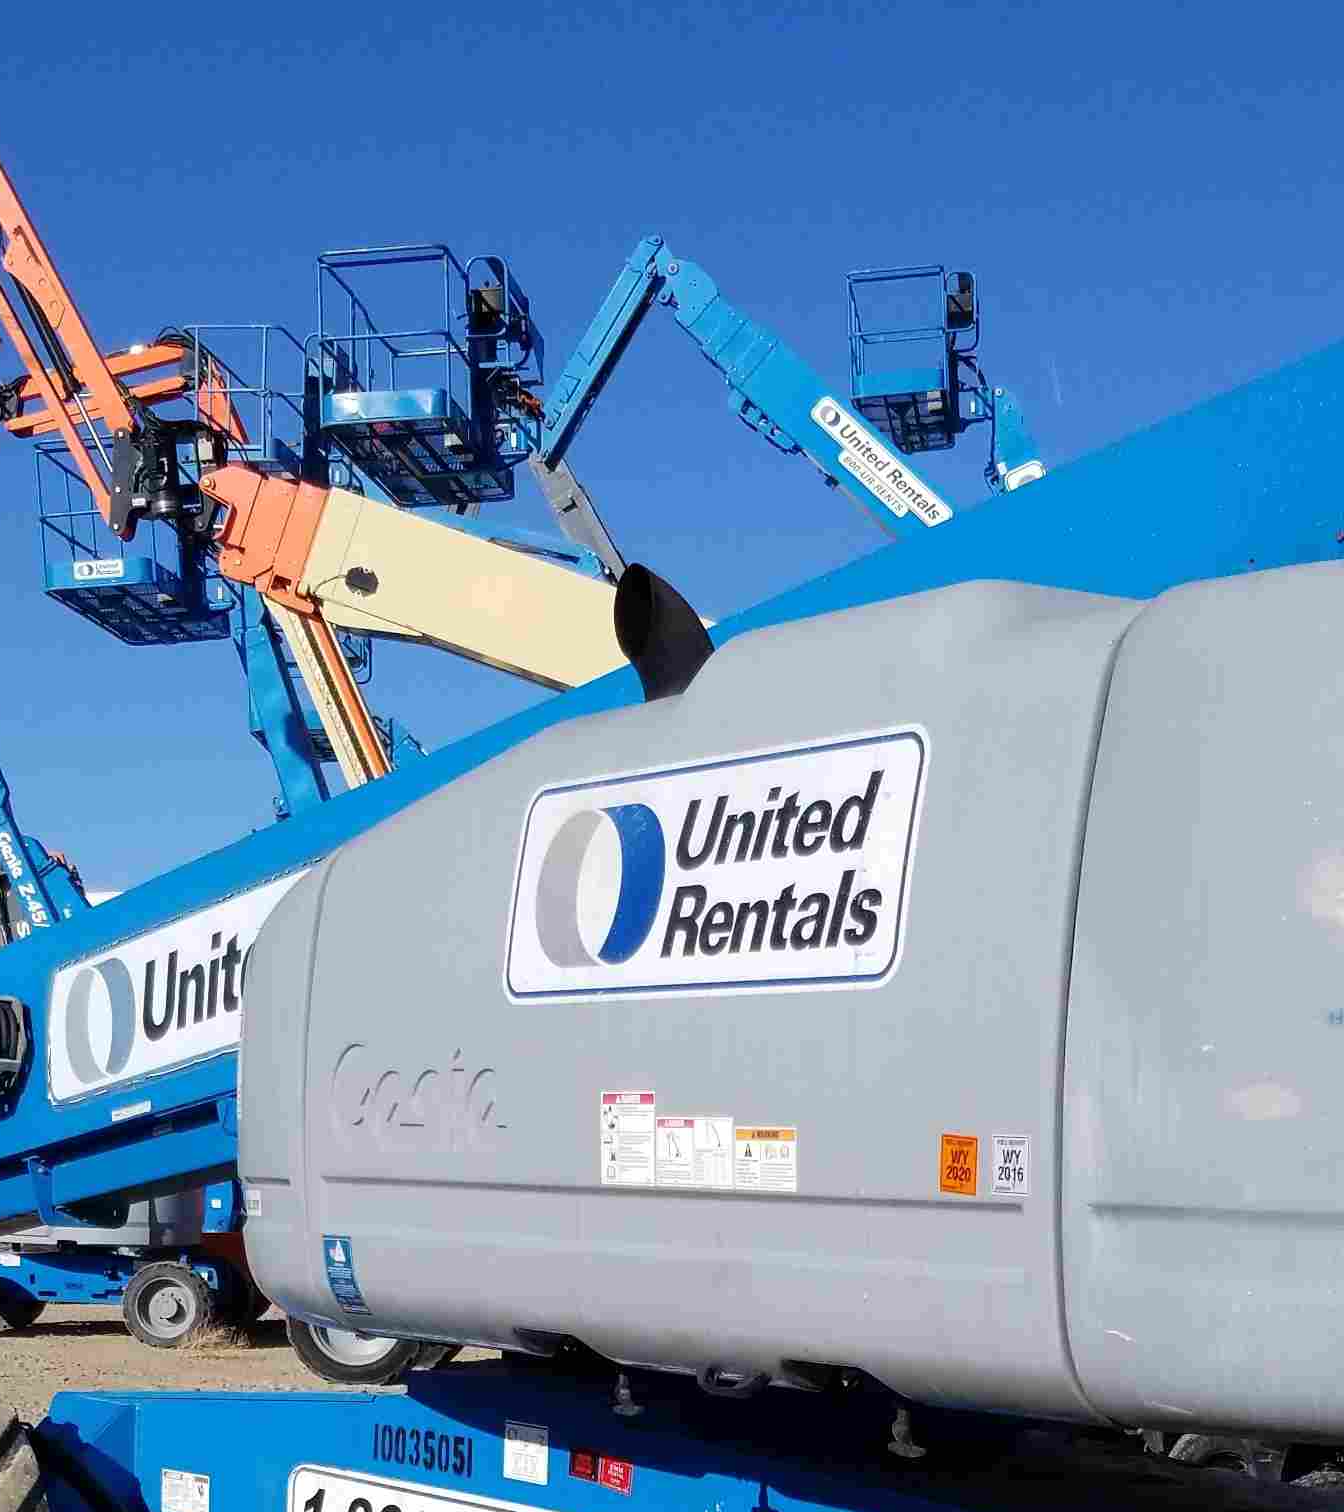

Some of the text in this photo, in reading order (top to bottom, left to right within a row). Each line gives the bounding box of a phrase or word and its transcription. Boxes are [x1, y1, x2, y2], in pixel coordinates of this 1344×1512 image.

[840, 424, 940, 520] United Rentals
[676, 770, 885, 871] United
[660, 869, 883, 958] Rentals
[143, 931, 255, 1042] Unit
[946, 1166, 971, 1182] 2020
[951, 1149, 969, 1165] WY
[998, 1166, 1024, 1182] 2016
[1002, 1149, 1022, 1164] WY
